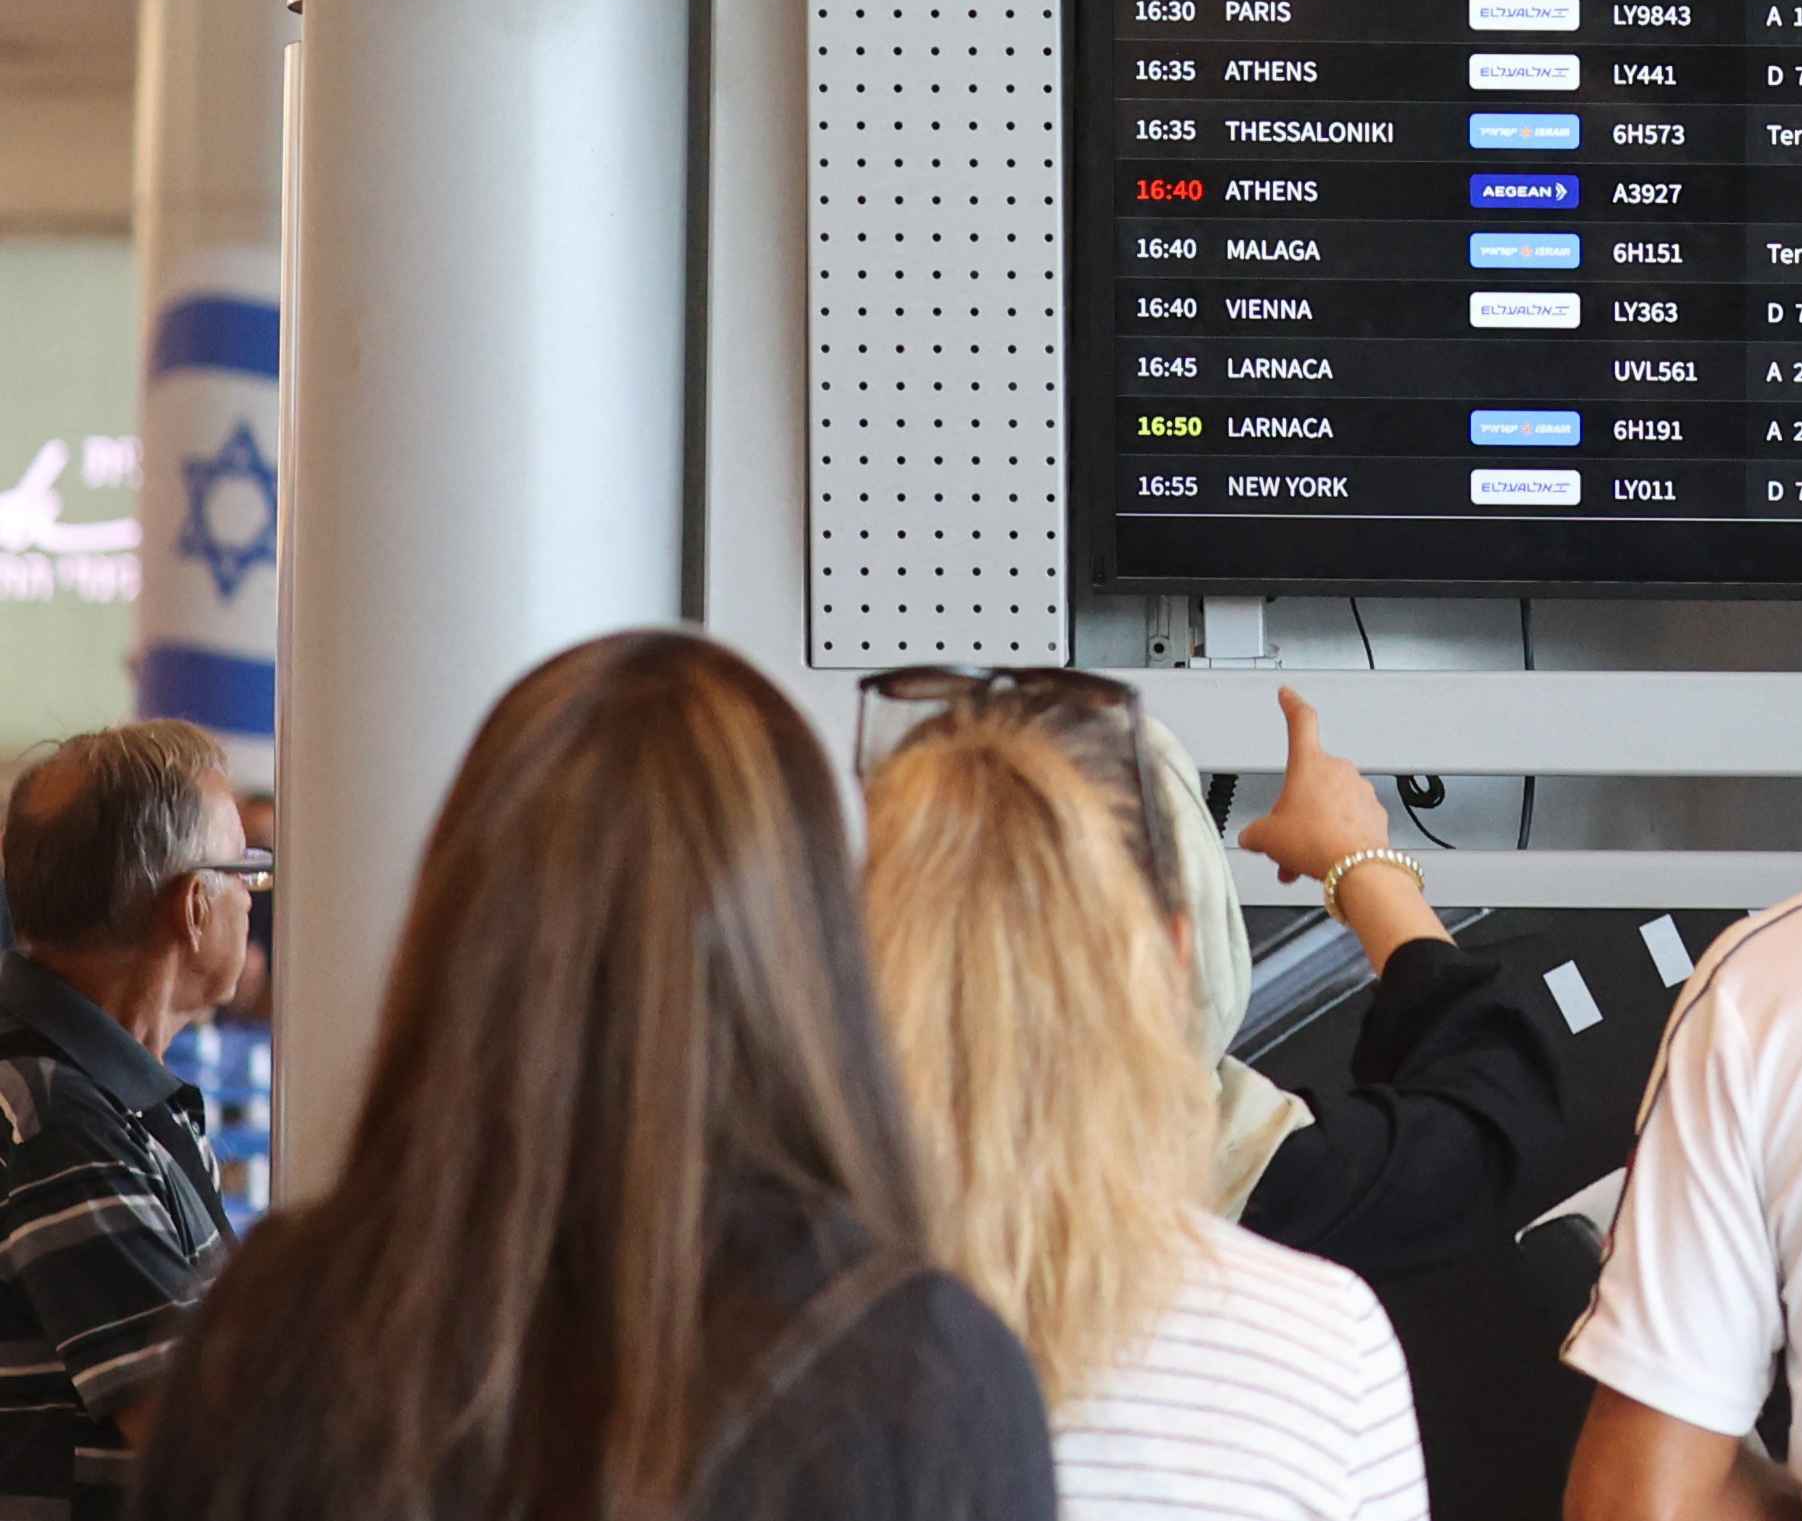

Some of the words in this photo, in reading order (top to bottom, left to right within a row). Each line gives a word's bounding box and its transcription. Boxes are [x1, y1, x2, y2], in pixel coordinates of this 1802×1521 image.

[1136, 178, 1205, 202] 16:40
[1224, 179, 1319, 203] ATHENS
[1482, 184, 1552, 198] AEGEAN
[1612, 182, 1683, 205] A3927
[1138, 475, 1199, 497] 16:55
[1228, 475, 1281, 497] NEW
[1284, 476, 1349, 498] YORK
[1614, 479, 1677, 501] LY011
[1767, 480, 1784, 503] D
